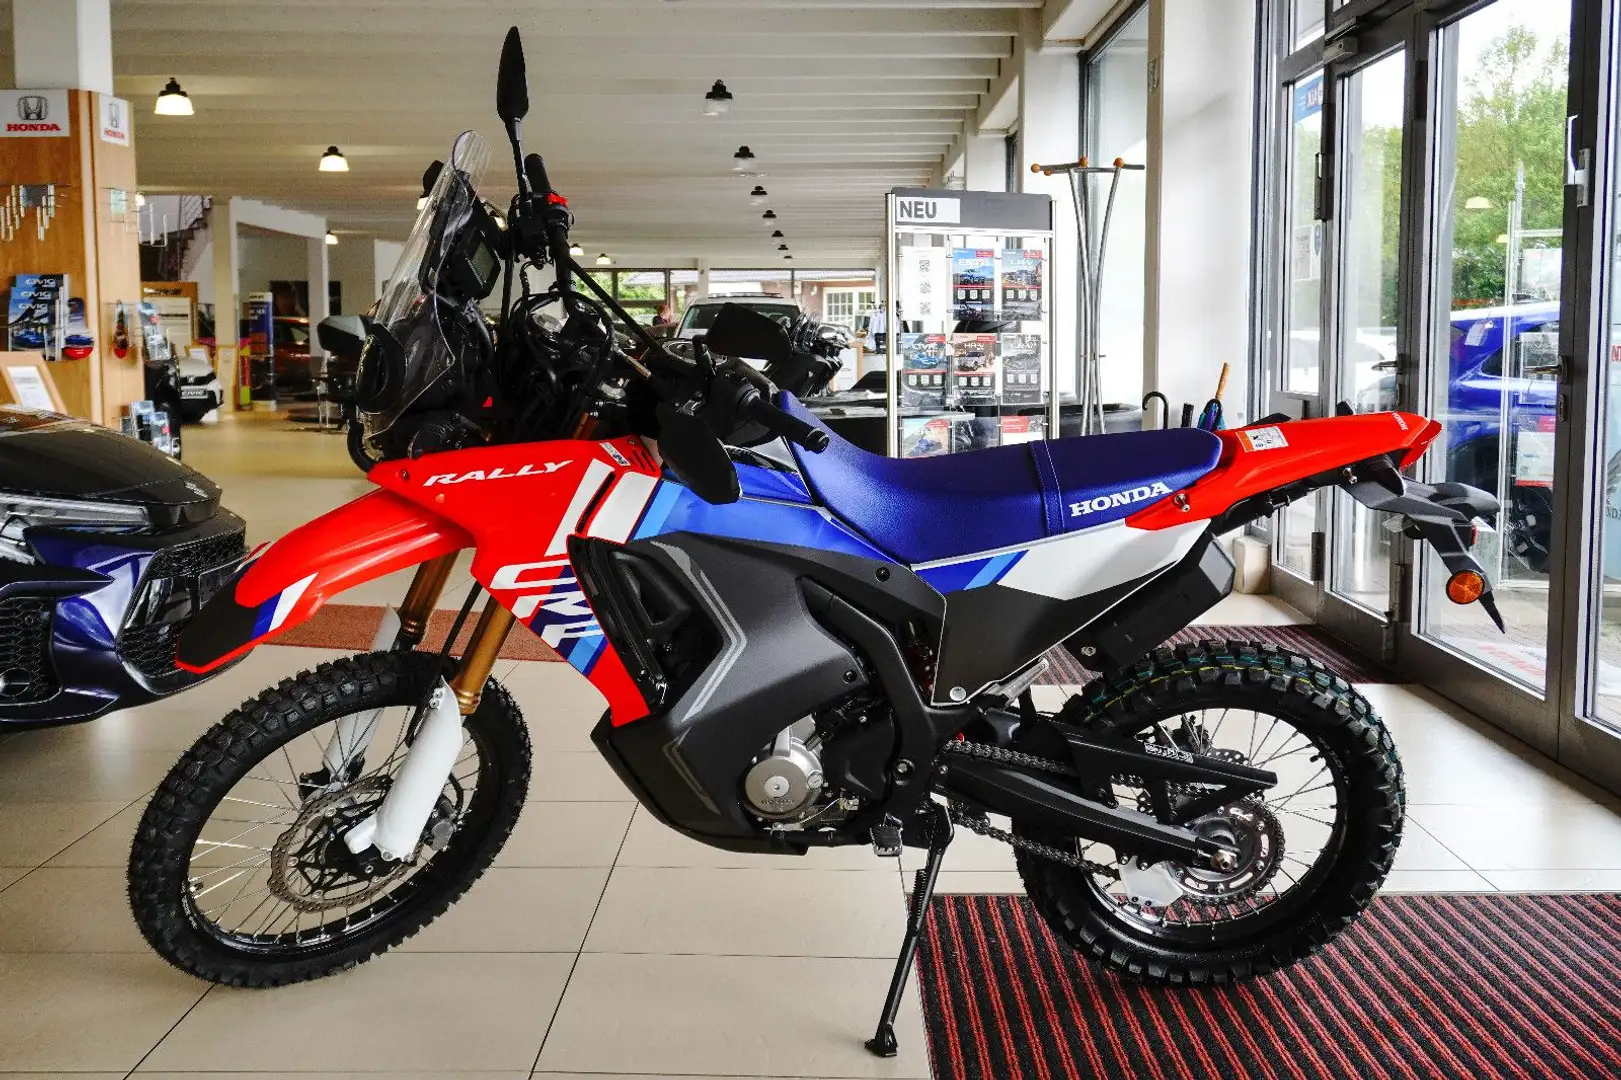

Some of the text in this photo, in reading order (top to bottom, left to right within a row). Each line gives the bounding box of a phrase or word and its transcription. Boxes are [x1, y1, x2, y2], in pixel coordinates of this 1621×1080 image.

[6, 123, 61, 132] HONDA
[103, 128, 125, 139] HONDA
[899, 200, 937, 219] NEU
[423, 460, 574, 487] RALLY
[1069, 481, 1173, 517] HONDA
[489, 559, 605, 649] CRF
